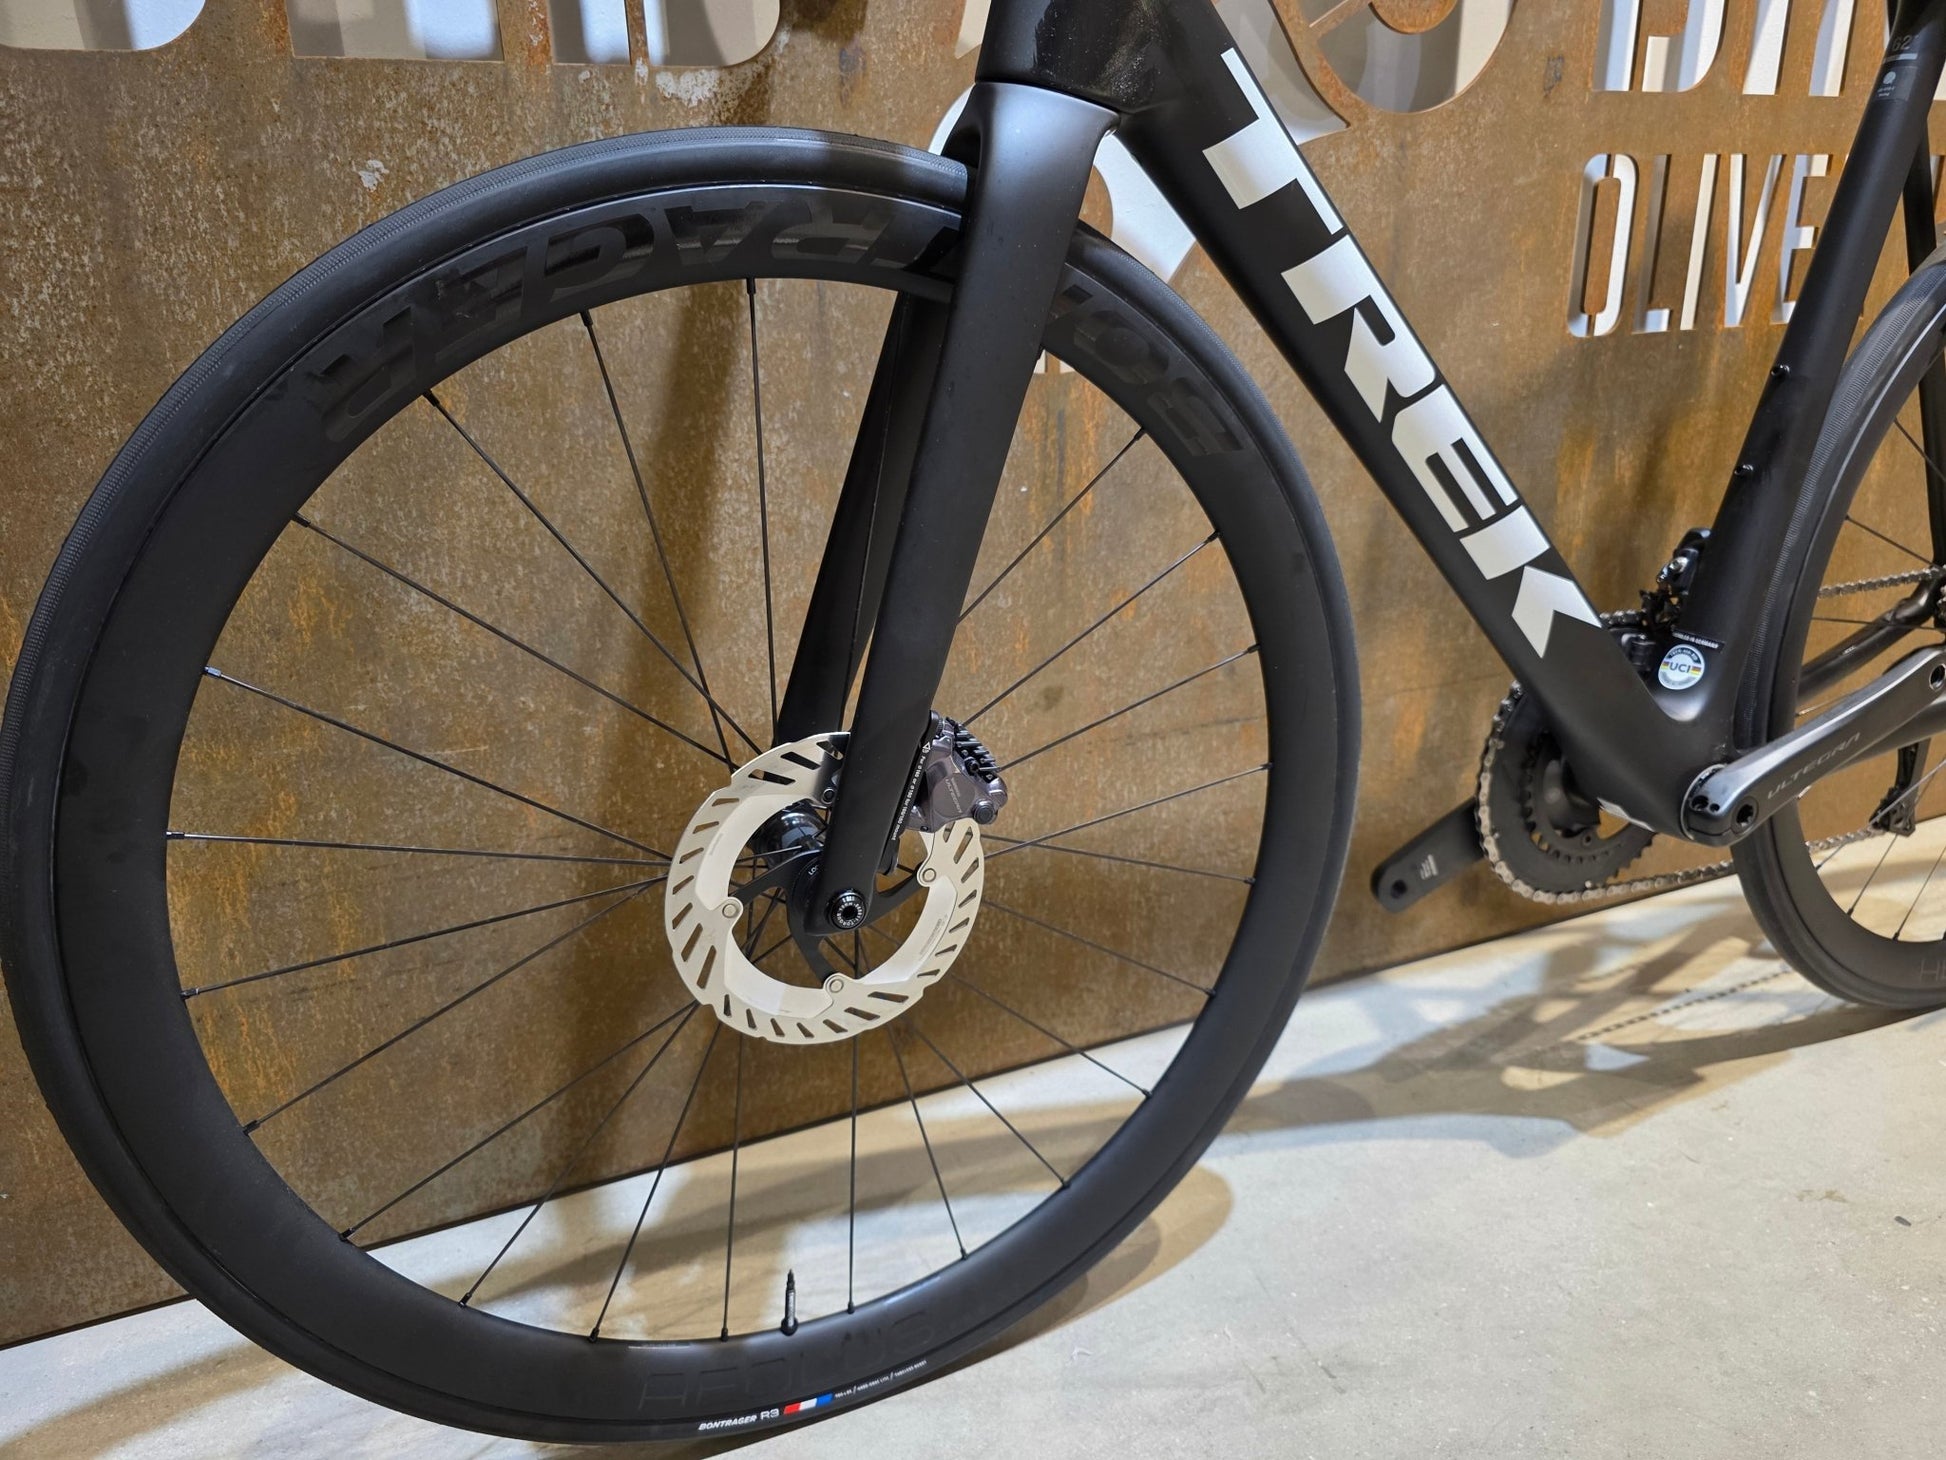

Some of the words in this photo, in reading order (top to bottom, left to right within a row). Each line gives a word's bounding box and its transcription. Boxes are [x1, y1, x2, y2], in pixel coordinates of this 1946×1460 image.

[1567, 153, 1851, 338] OLIVE
[1202, 48, 1602, 658] TREK
[1669, 661, 1691, 674] UCI
[698, 1415, 757, 1431] BONTRAGER
[760, 1408, 780, 1420] R3
